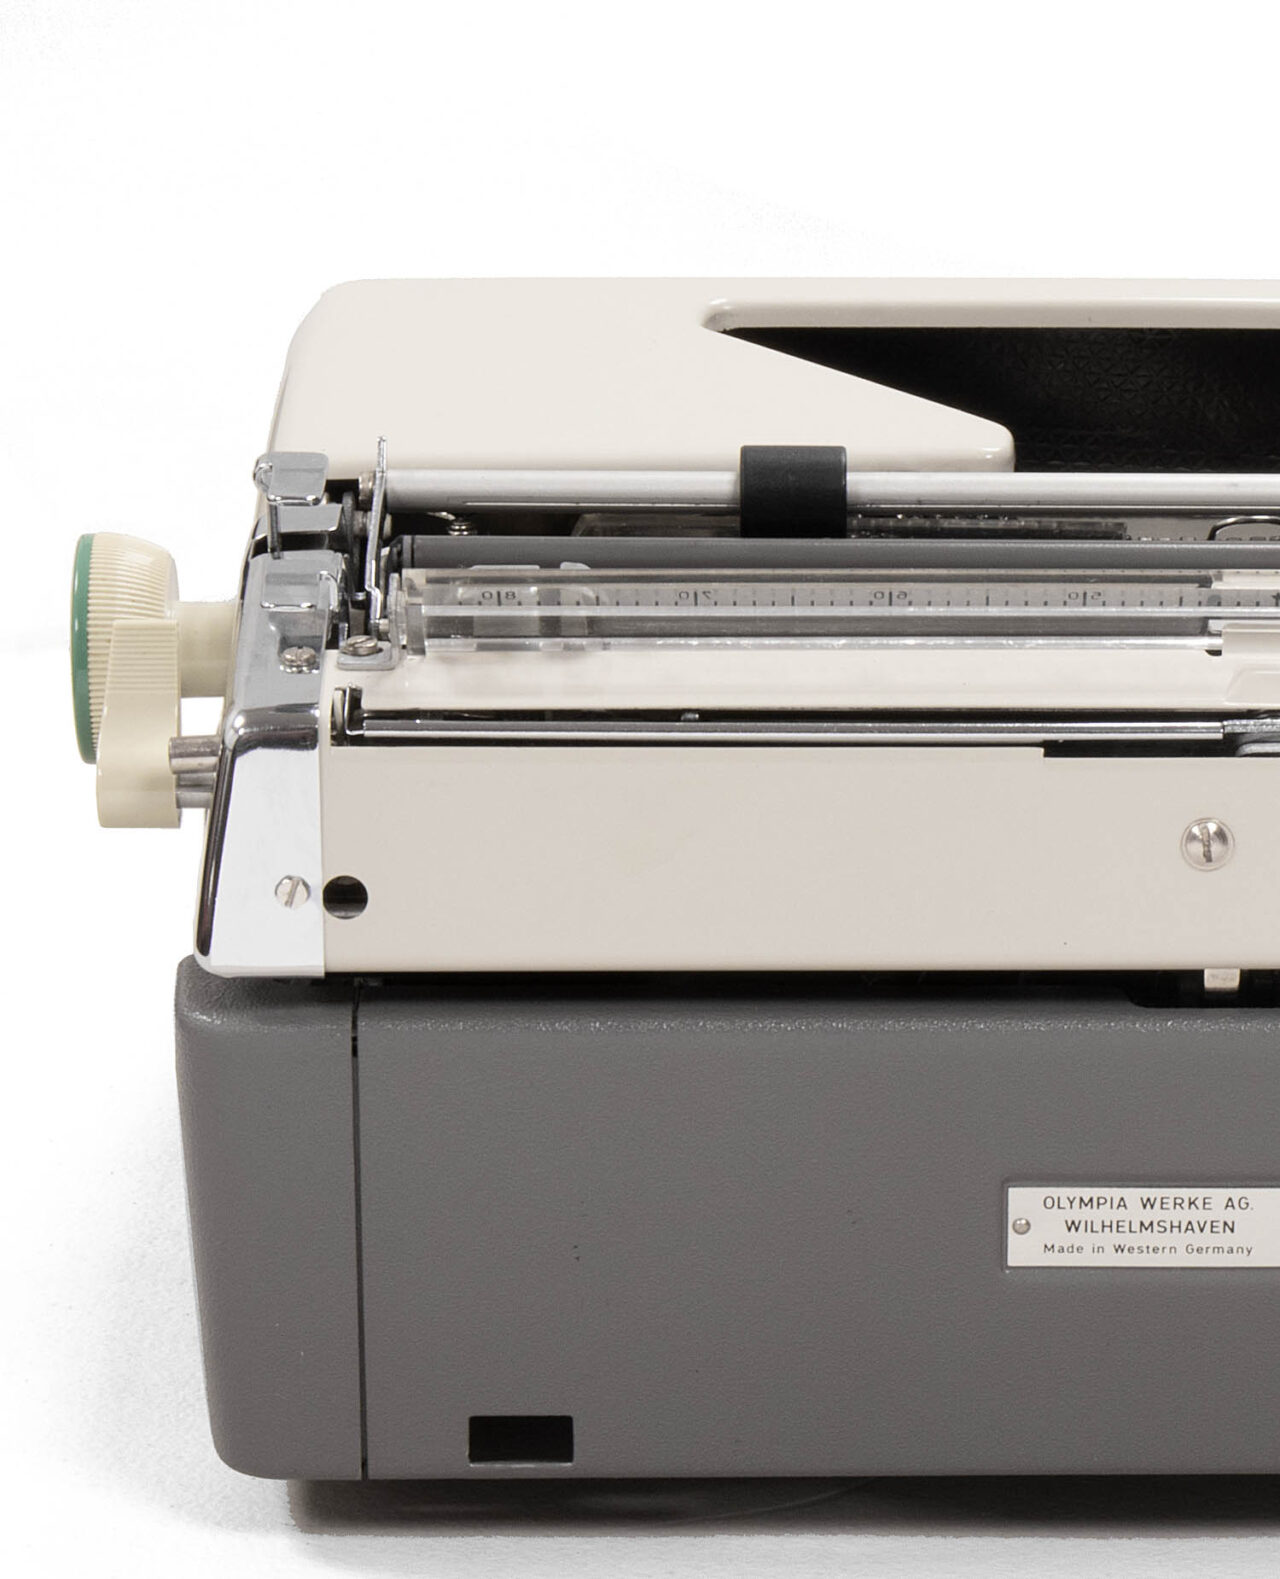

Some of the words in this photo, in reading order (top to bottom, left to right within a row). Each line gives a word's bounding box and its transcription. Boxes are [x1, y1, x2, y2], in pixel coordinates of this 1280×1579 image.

[1043, 1196, 1128, 1210] OLYMPIA
[1140, 1196, 1213, 1210] WERKE
[1224, 1196, 1254, 1210] AG.
[1064, 1219, 1236, 1234] WILHELMSHAVEN
[1043, 1243, 1084, 1254] Made
[1092, 1243, 1105, 1254] in
[1113, 1243, 1177, 1254] Western
[1185, 1243, 1253, 1256] Germany
